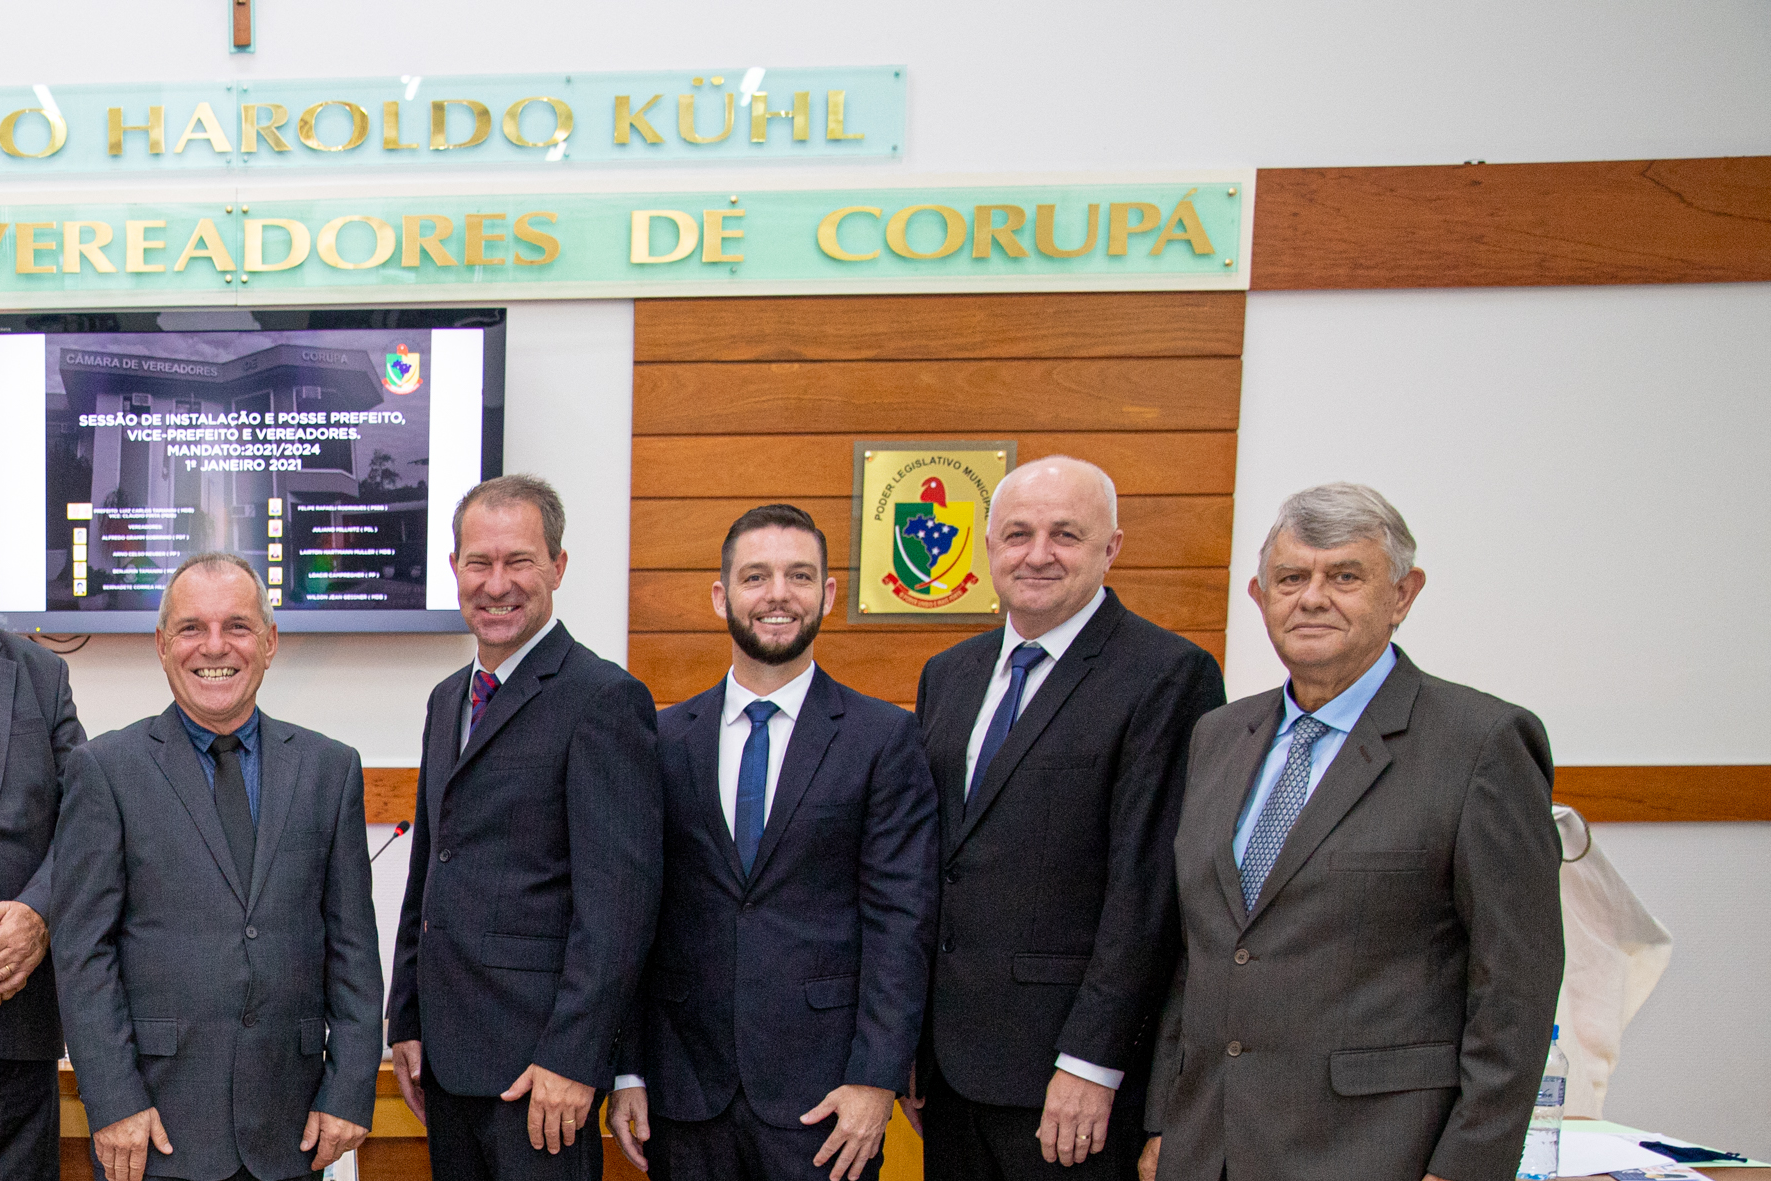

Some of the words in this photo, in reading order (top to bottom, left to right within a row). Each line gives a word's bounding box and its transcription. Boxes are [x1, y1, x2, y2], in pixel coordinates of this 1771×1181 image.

[107, 96, 574, 155] HAROLDO
[614, 76, 865, 144] KÜHL
[630, 208, 745, 264] DE
[817, 188, 1216, 261] CORUPÁ
[122, 358, 139, 369] DE
[141, 360, 218, 376] VEREADORES
[79, 412, 138, 427] SESSÃO
[141, 414, 162, 426] DE
[165, 410, 261, 427] INSTALAÇÃO
[265, 412, 275, 425] E
[278, 412, 327, 424] POSSE
[330, 411, 406, 425] PREFEITO,
[127, 428, 240, 441] VICE-PREFEITO
[242, 428, 253, 440] E
[256, 427, 361, 440] VEREADORES.
[167, 443, 321, 457] MANDATO:2021/2024
[200, 459, 266, 472] JANEIRO
[269, 458, 302, 471] 2021
[874, 483, 895, 522] PODER
[892, 456, 962, 484] LEGISLATIVO
